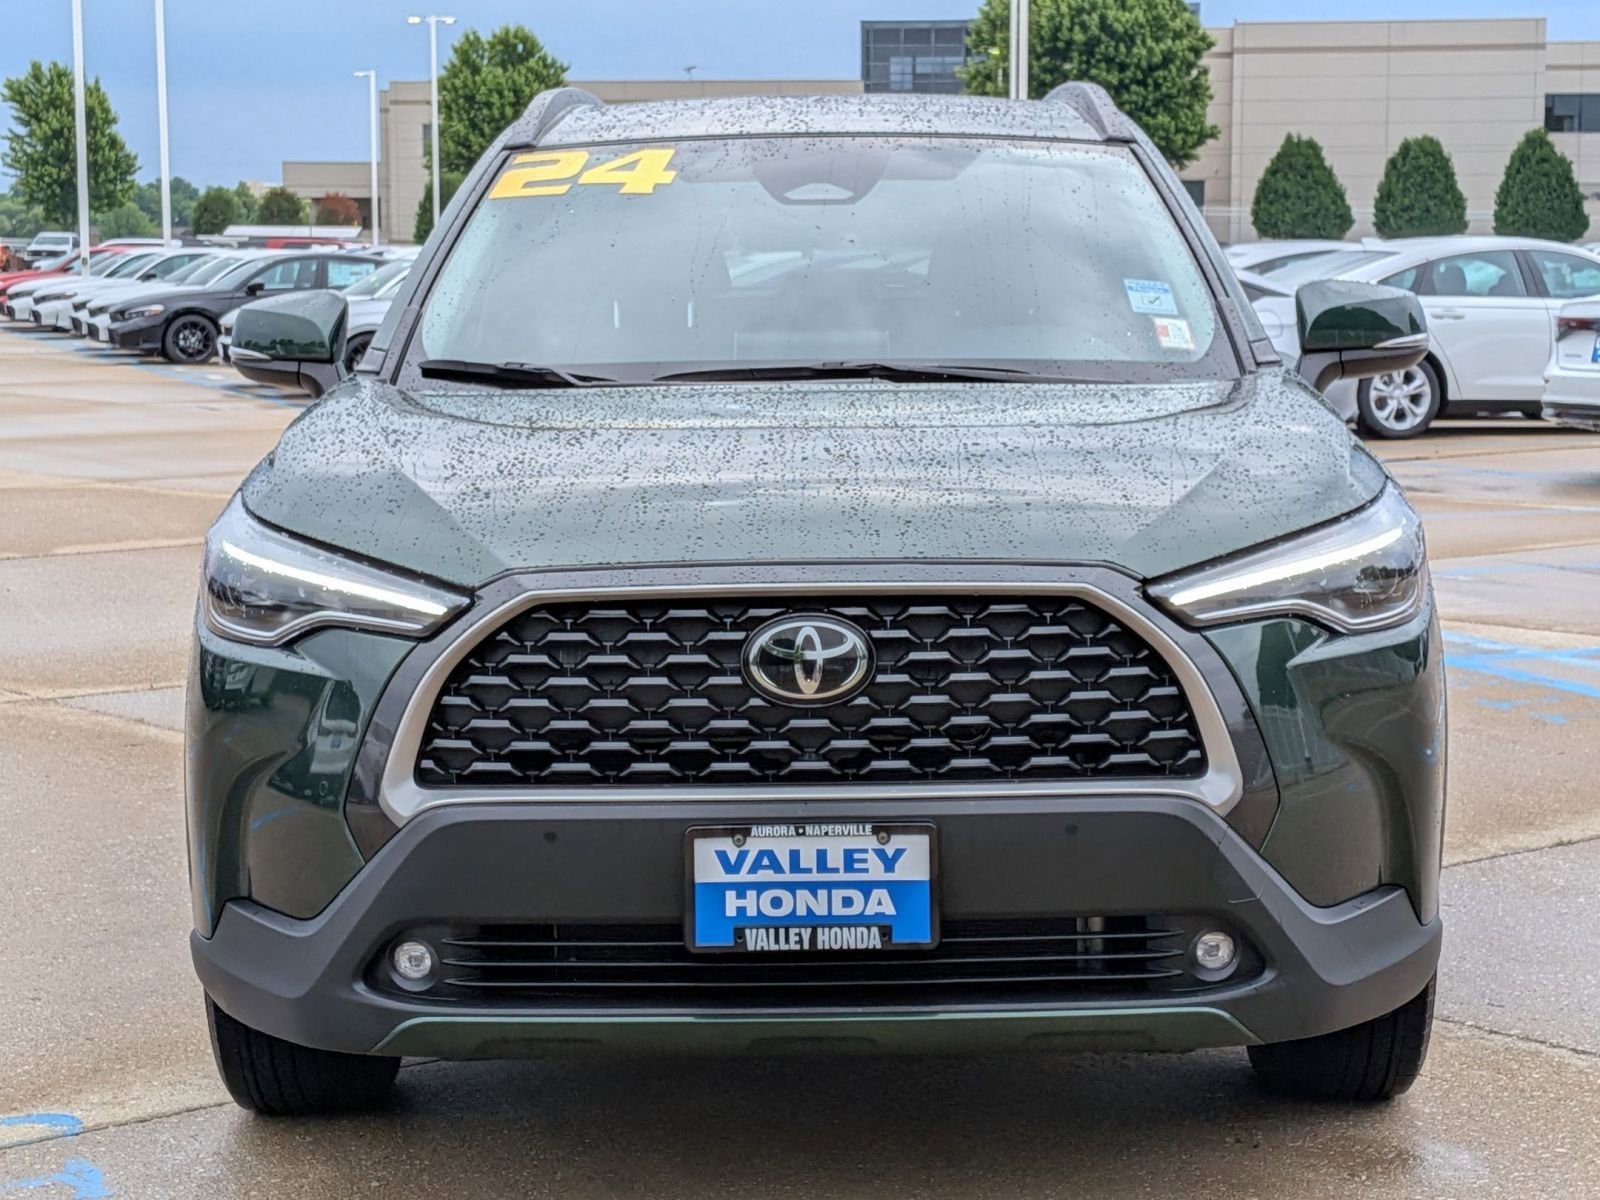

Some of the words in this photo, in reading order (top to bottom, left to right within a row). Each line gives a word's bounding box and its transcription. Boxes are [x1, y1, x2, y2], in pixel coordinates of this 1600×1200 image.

[488, 148, 677, 199] 24
[751, 825, 796, 837] AURORA
[805, 824, 873, 836] NAPERVILLE
[714, 848, 908, 875] VALLEY
[725, 889, 896, 917] HONDA
[745, 927, 812, 951] VALLEY
[816, 926, 882, 950] HONDA
